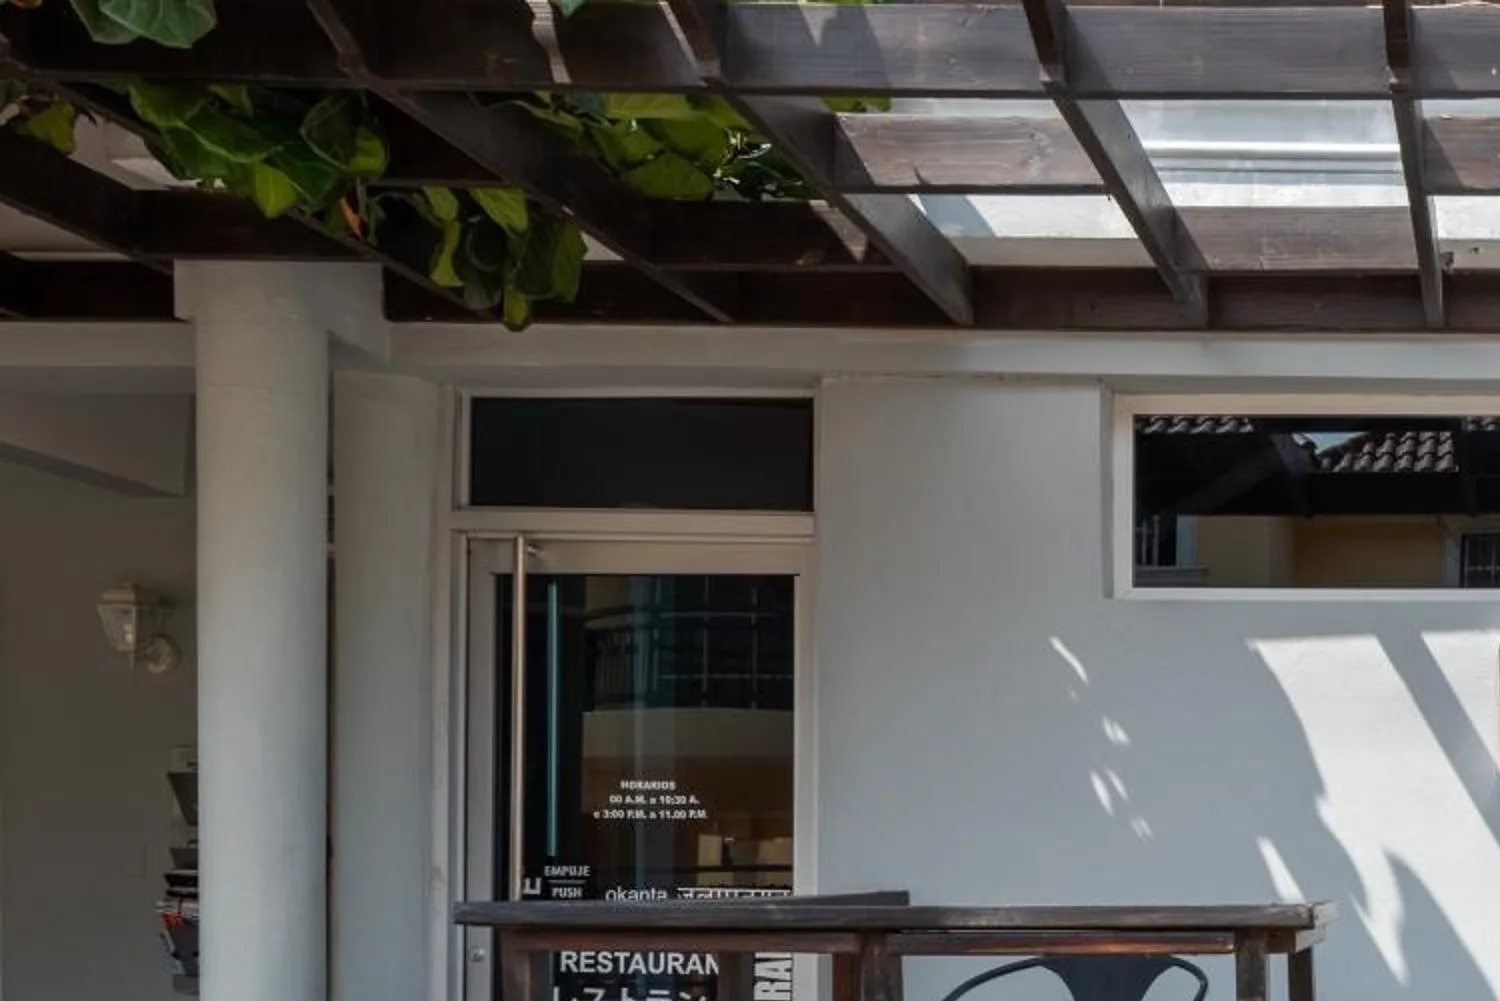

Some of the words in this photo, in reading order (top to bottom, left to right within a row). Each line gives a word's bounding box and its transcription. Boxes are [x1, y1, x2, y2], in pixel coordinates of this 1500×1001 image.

[620, 780, 676, 790] HORARIOS
[544, 865, 591, 877] EMPUJE
[552, 887, 583, 898] PUSH
[560, 950, 719, 975] RESTAURAN
